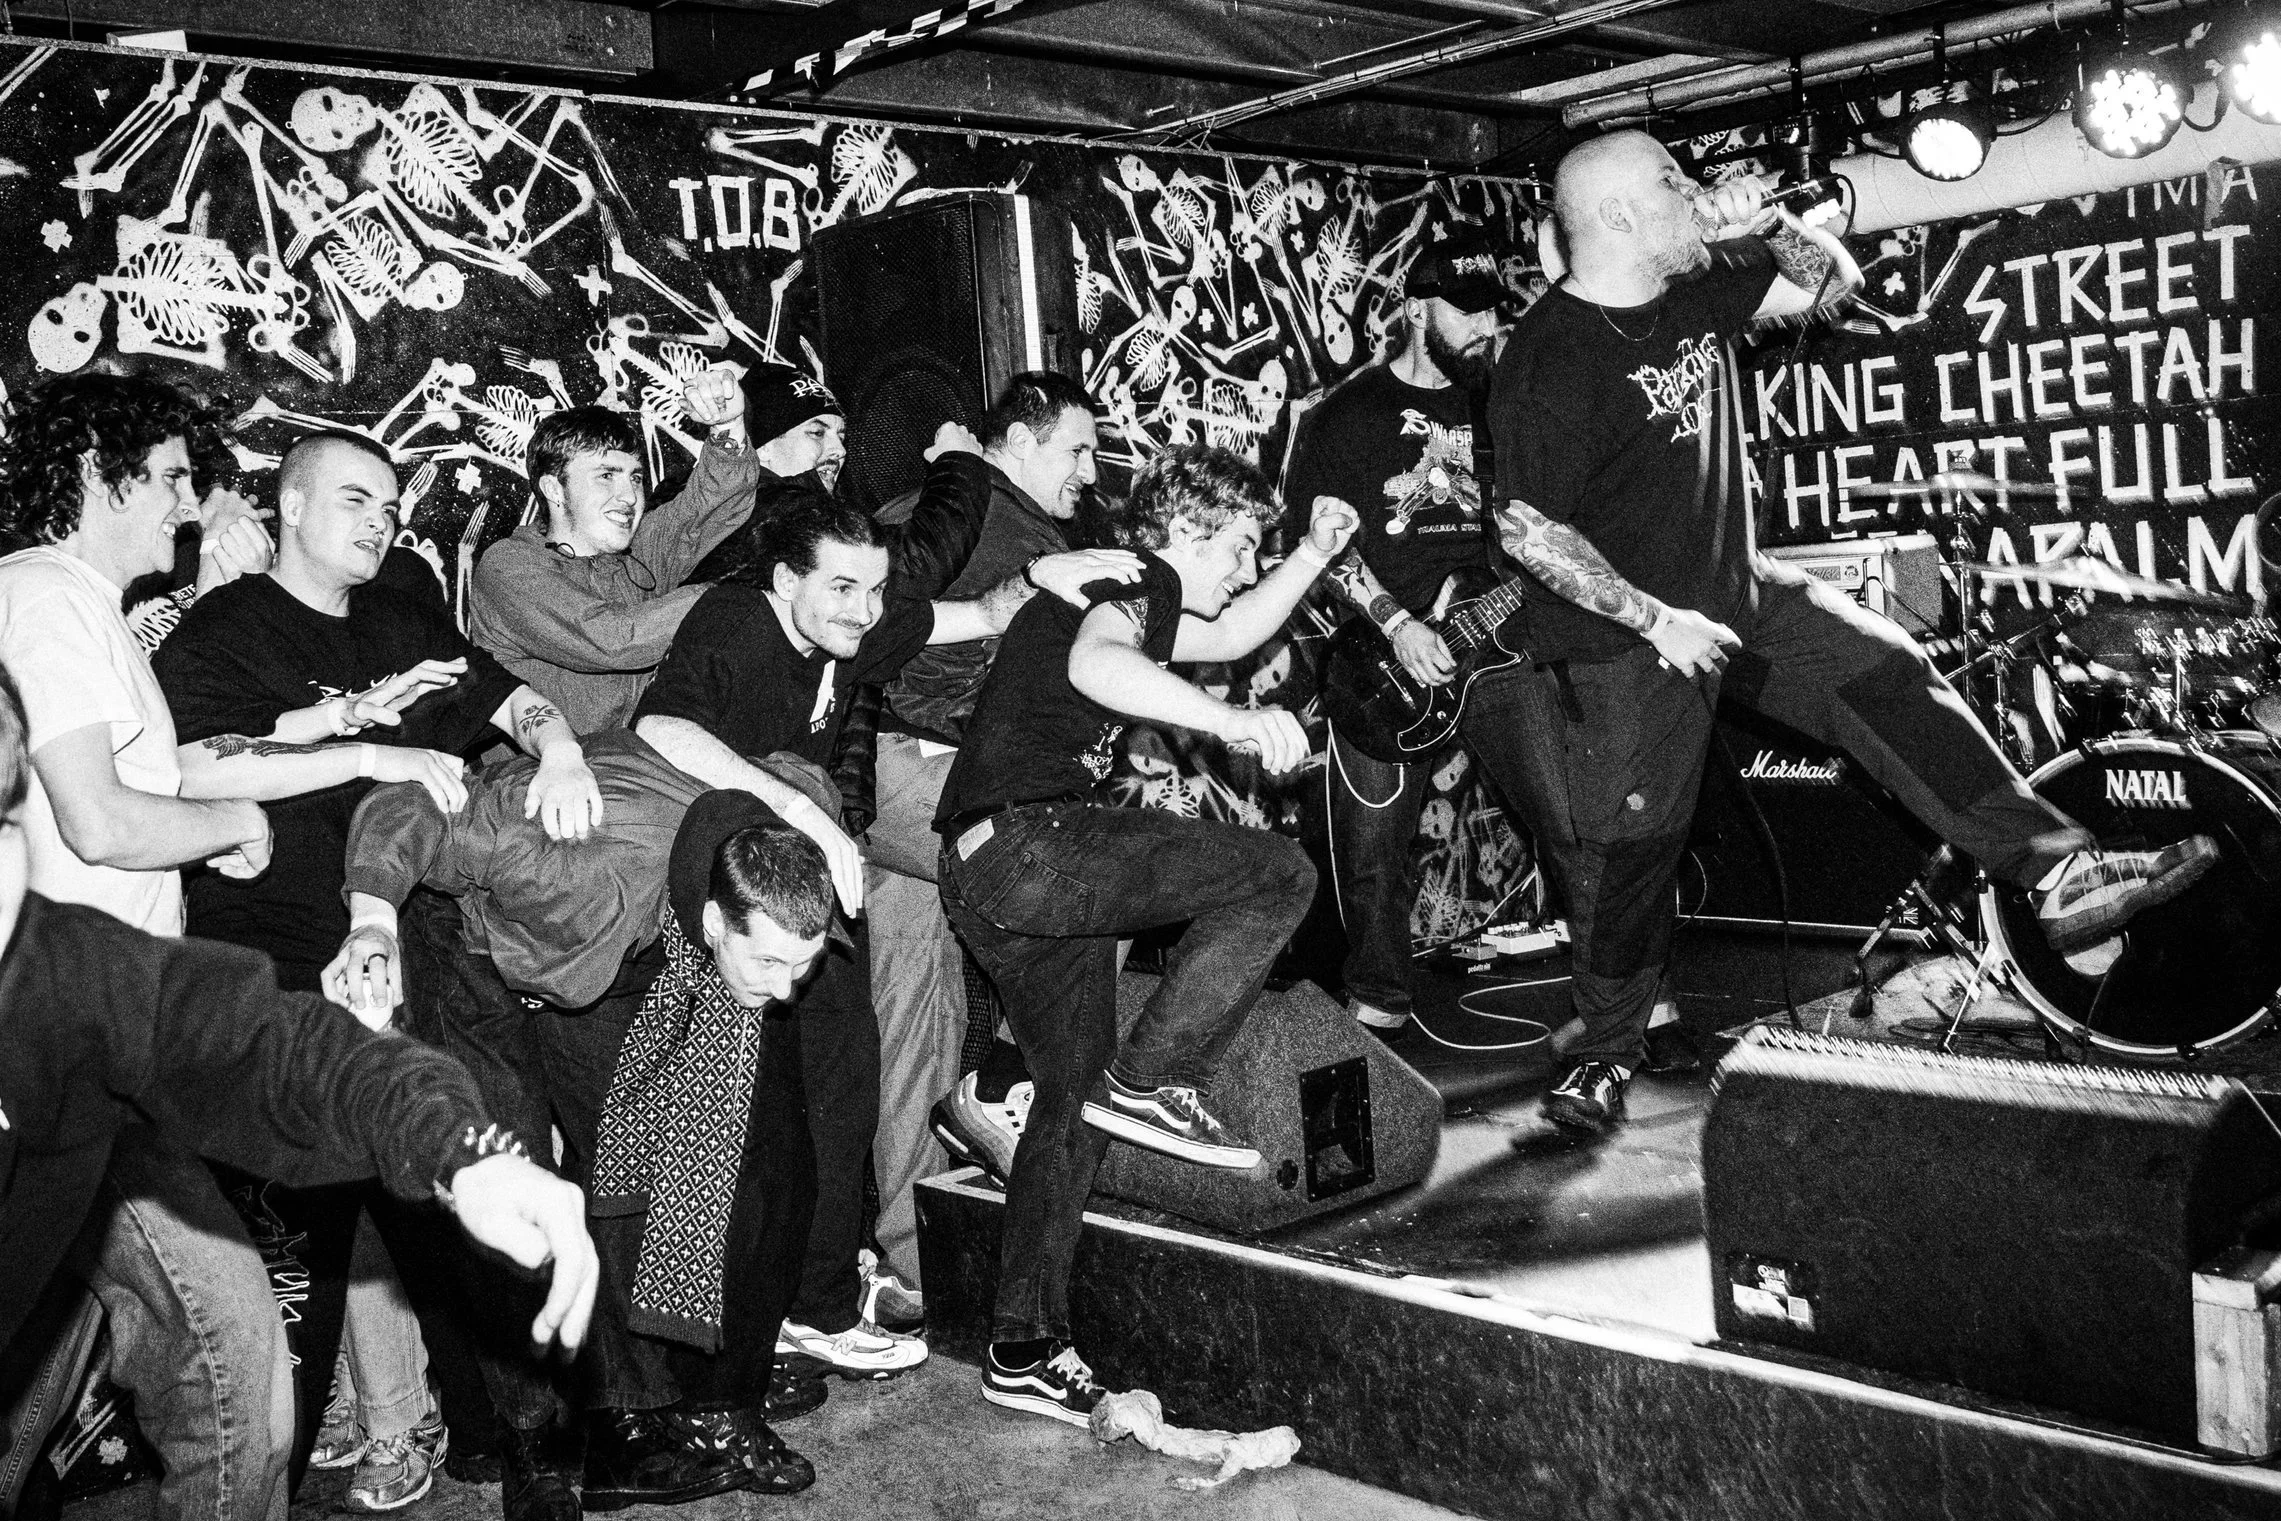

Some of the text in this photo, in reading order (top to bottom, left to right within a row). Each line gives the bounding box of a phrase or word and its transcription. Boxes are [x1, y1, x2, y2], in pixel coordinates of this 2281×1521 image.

[1963, 224, 2250, 344] STREET
[1745, 355, 1903, 443] KING
[1935, 317, 2254, 424] CHEETAH
[1784, 436, 2025, 528] HEART
[2048, 416, 2255, 512] FULL
[2105, 769, 2188, 803] NATAL
